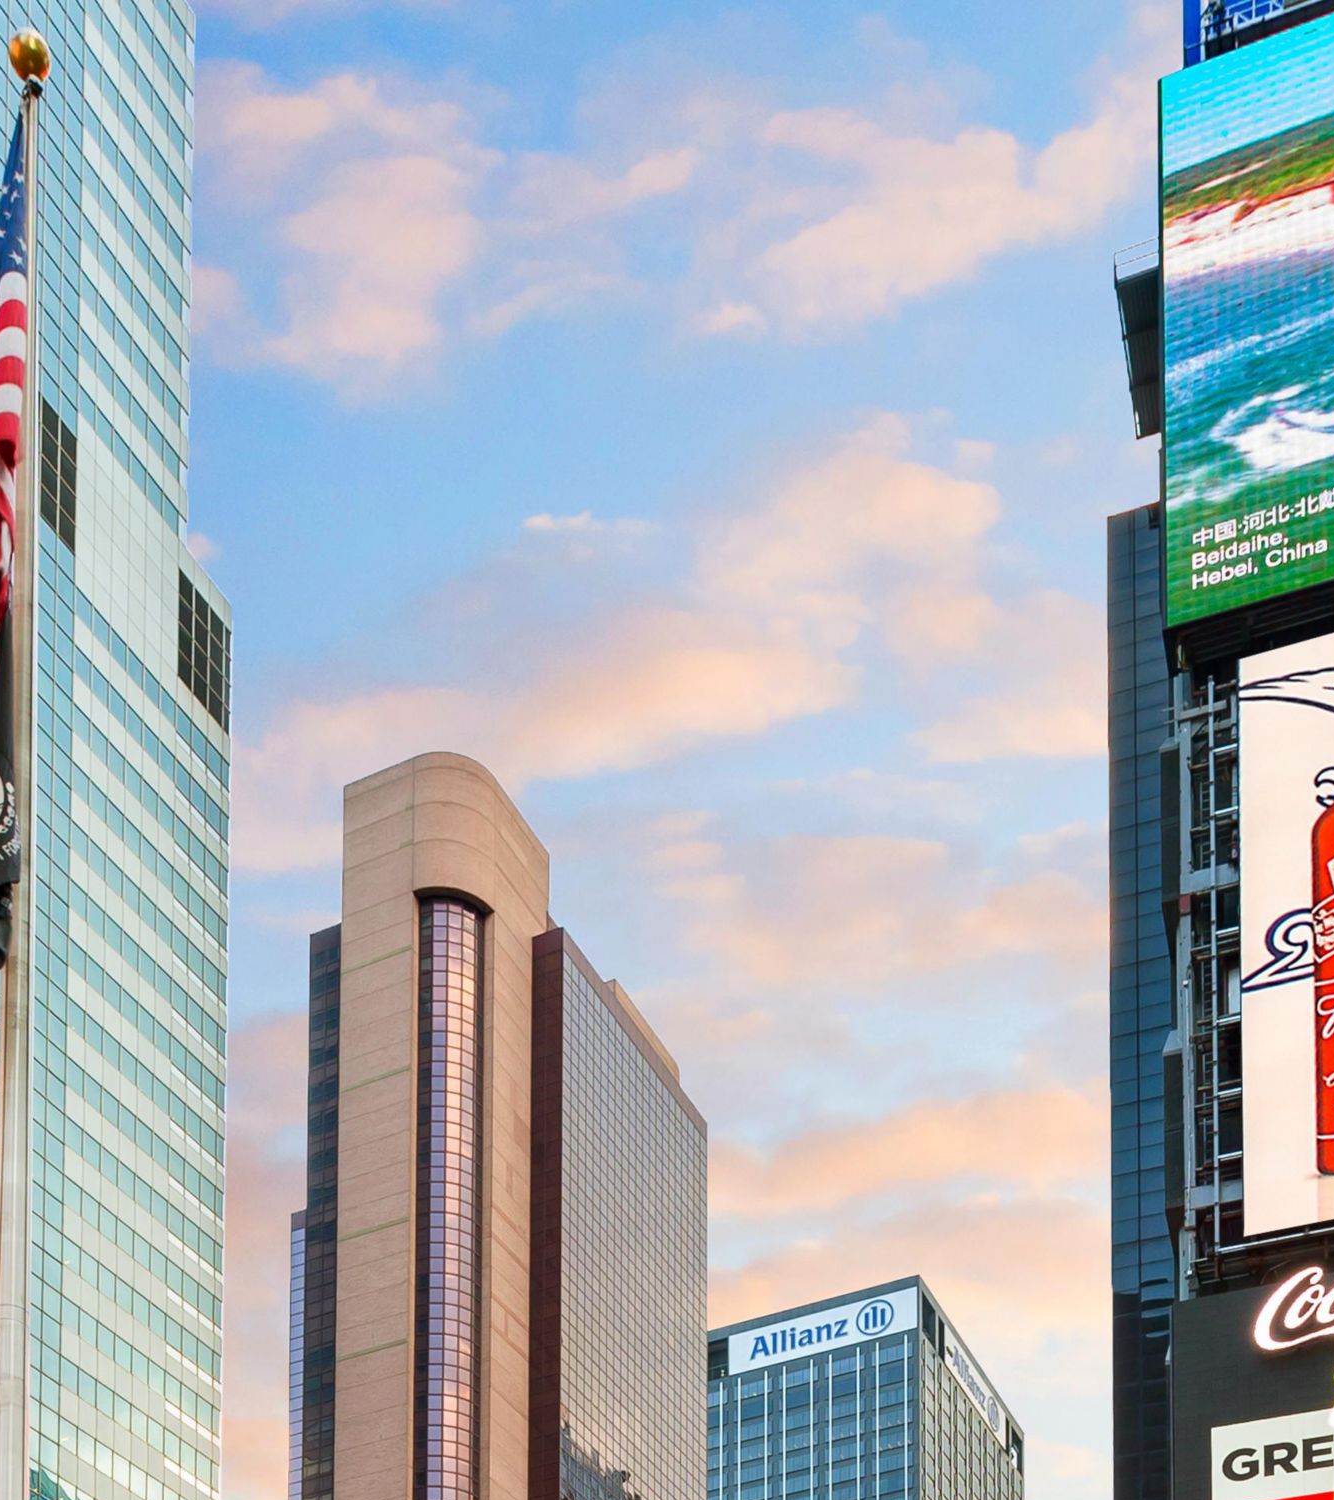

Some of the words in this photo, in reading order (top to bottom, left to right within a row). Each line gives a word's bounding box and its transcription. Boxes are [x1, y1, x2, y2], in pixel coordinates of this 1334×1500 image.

[1192, 532, 1289, 570] Beidaihe,
[1192, 558, 1258, 590] Hebei,
[1265, 539, 1328, 567] China
[750, 1318, 848, 1361] Allianz
[953, 1344, 987, 1412] Allianz
